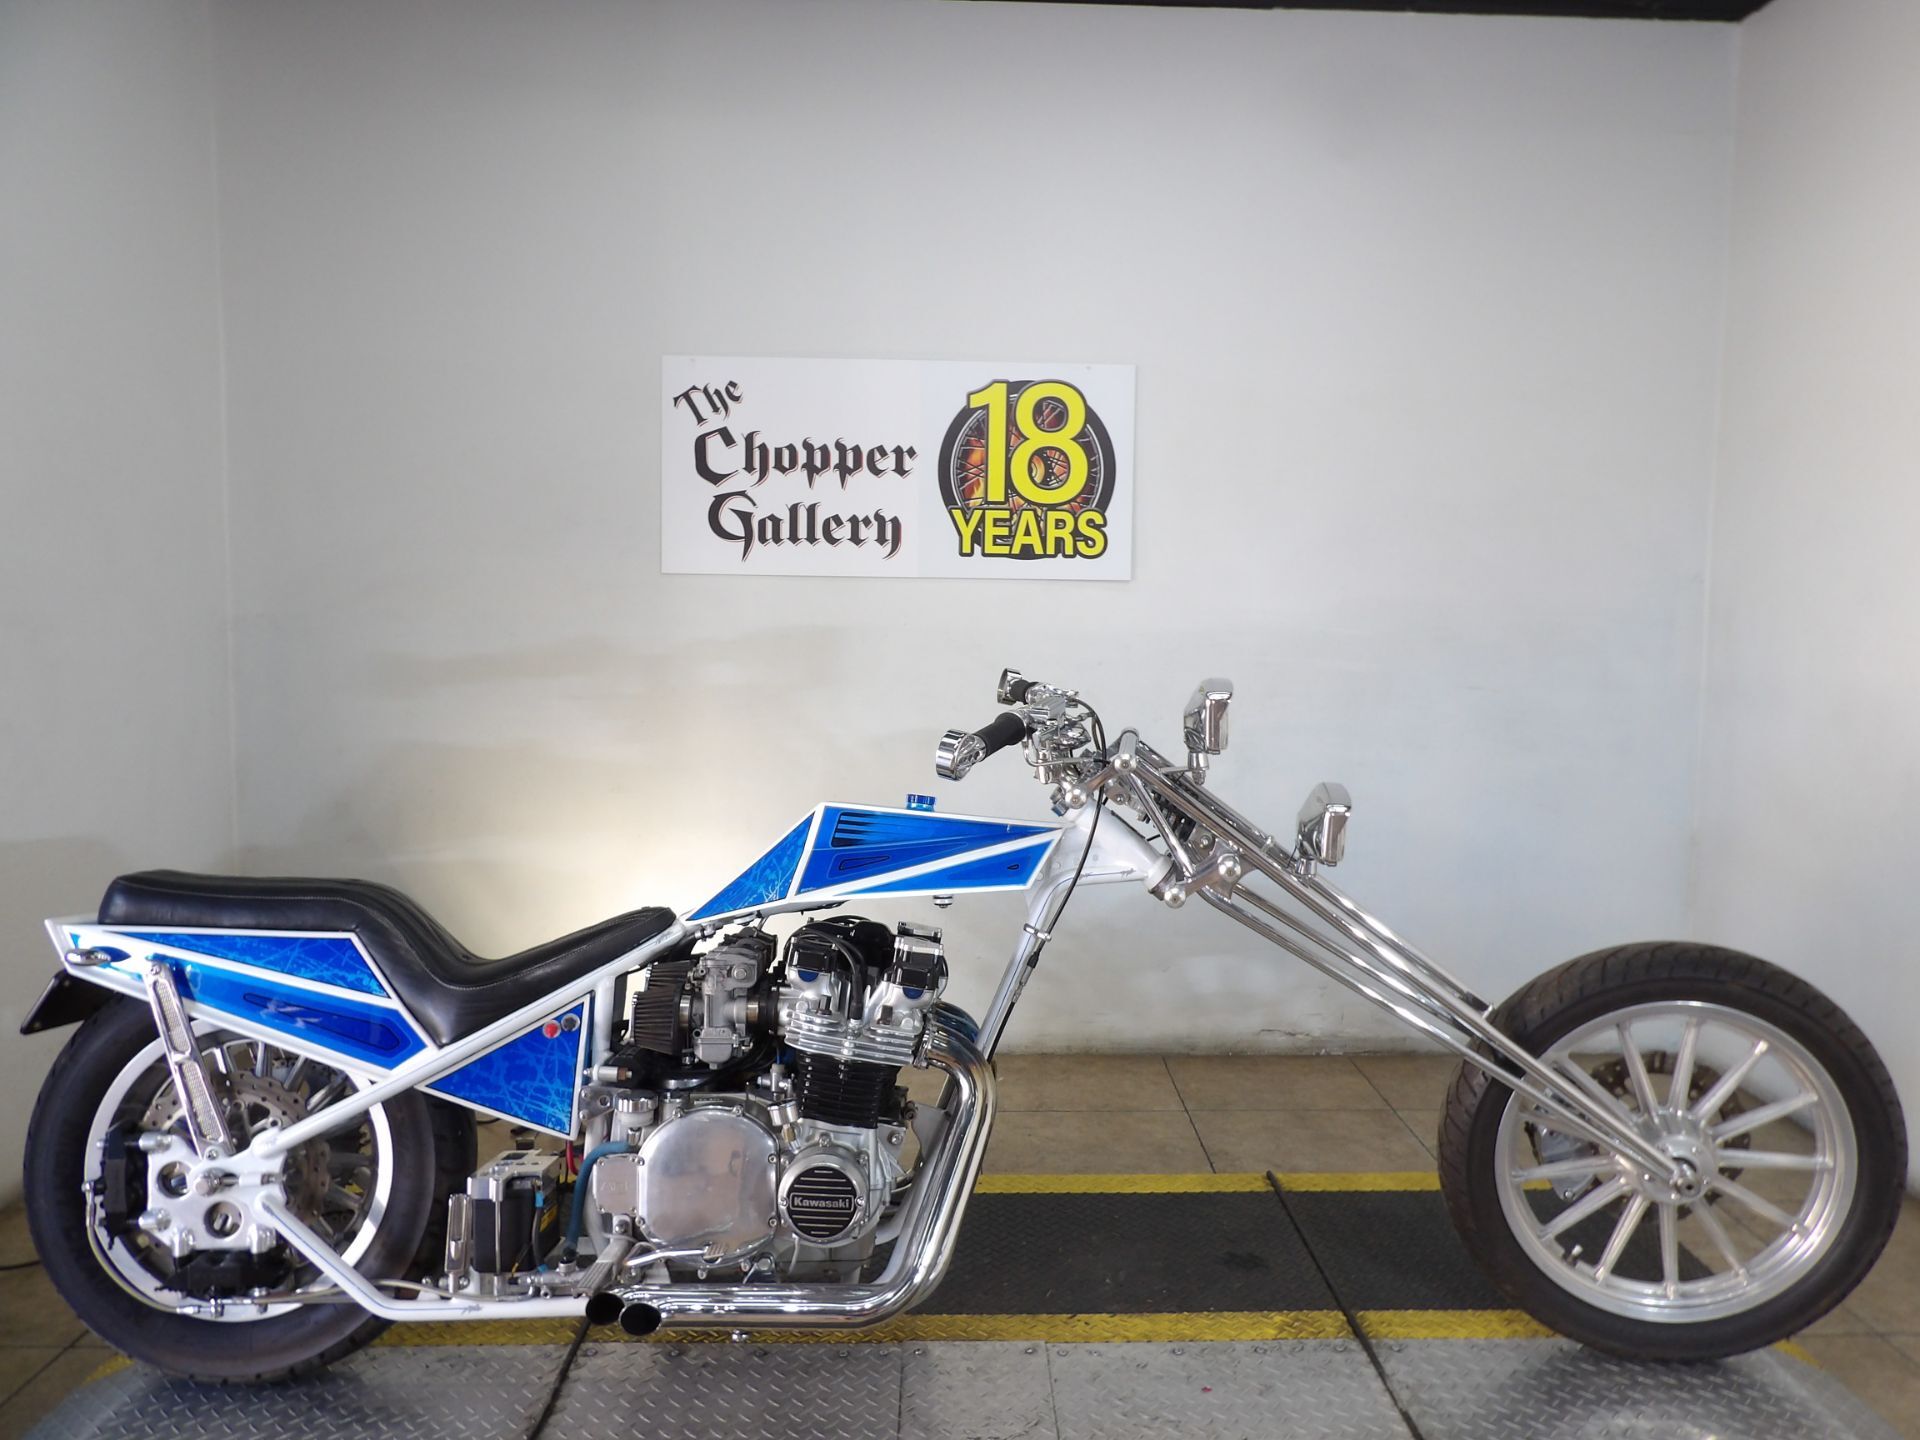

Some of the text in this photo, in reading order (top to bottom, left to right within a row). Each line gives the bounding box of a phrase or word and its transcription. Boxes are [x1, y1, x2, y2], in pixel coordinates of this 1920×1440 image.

[673, 379, 743, 426] The
[694, 427, 917, 489] Chopper
[968, 380, 1090, 506] 18
[707, 490, 903, 561] Gallery
[950, 508, 1107, 559] YEARS
[794, 1196, 849, 1208] Kawasaki
